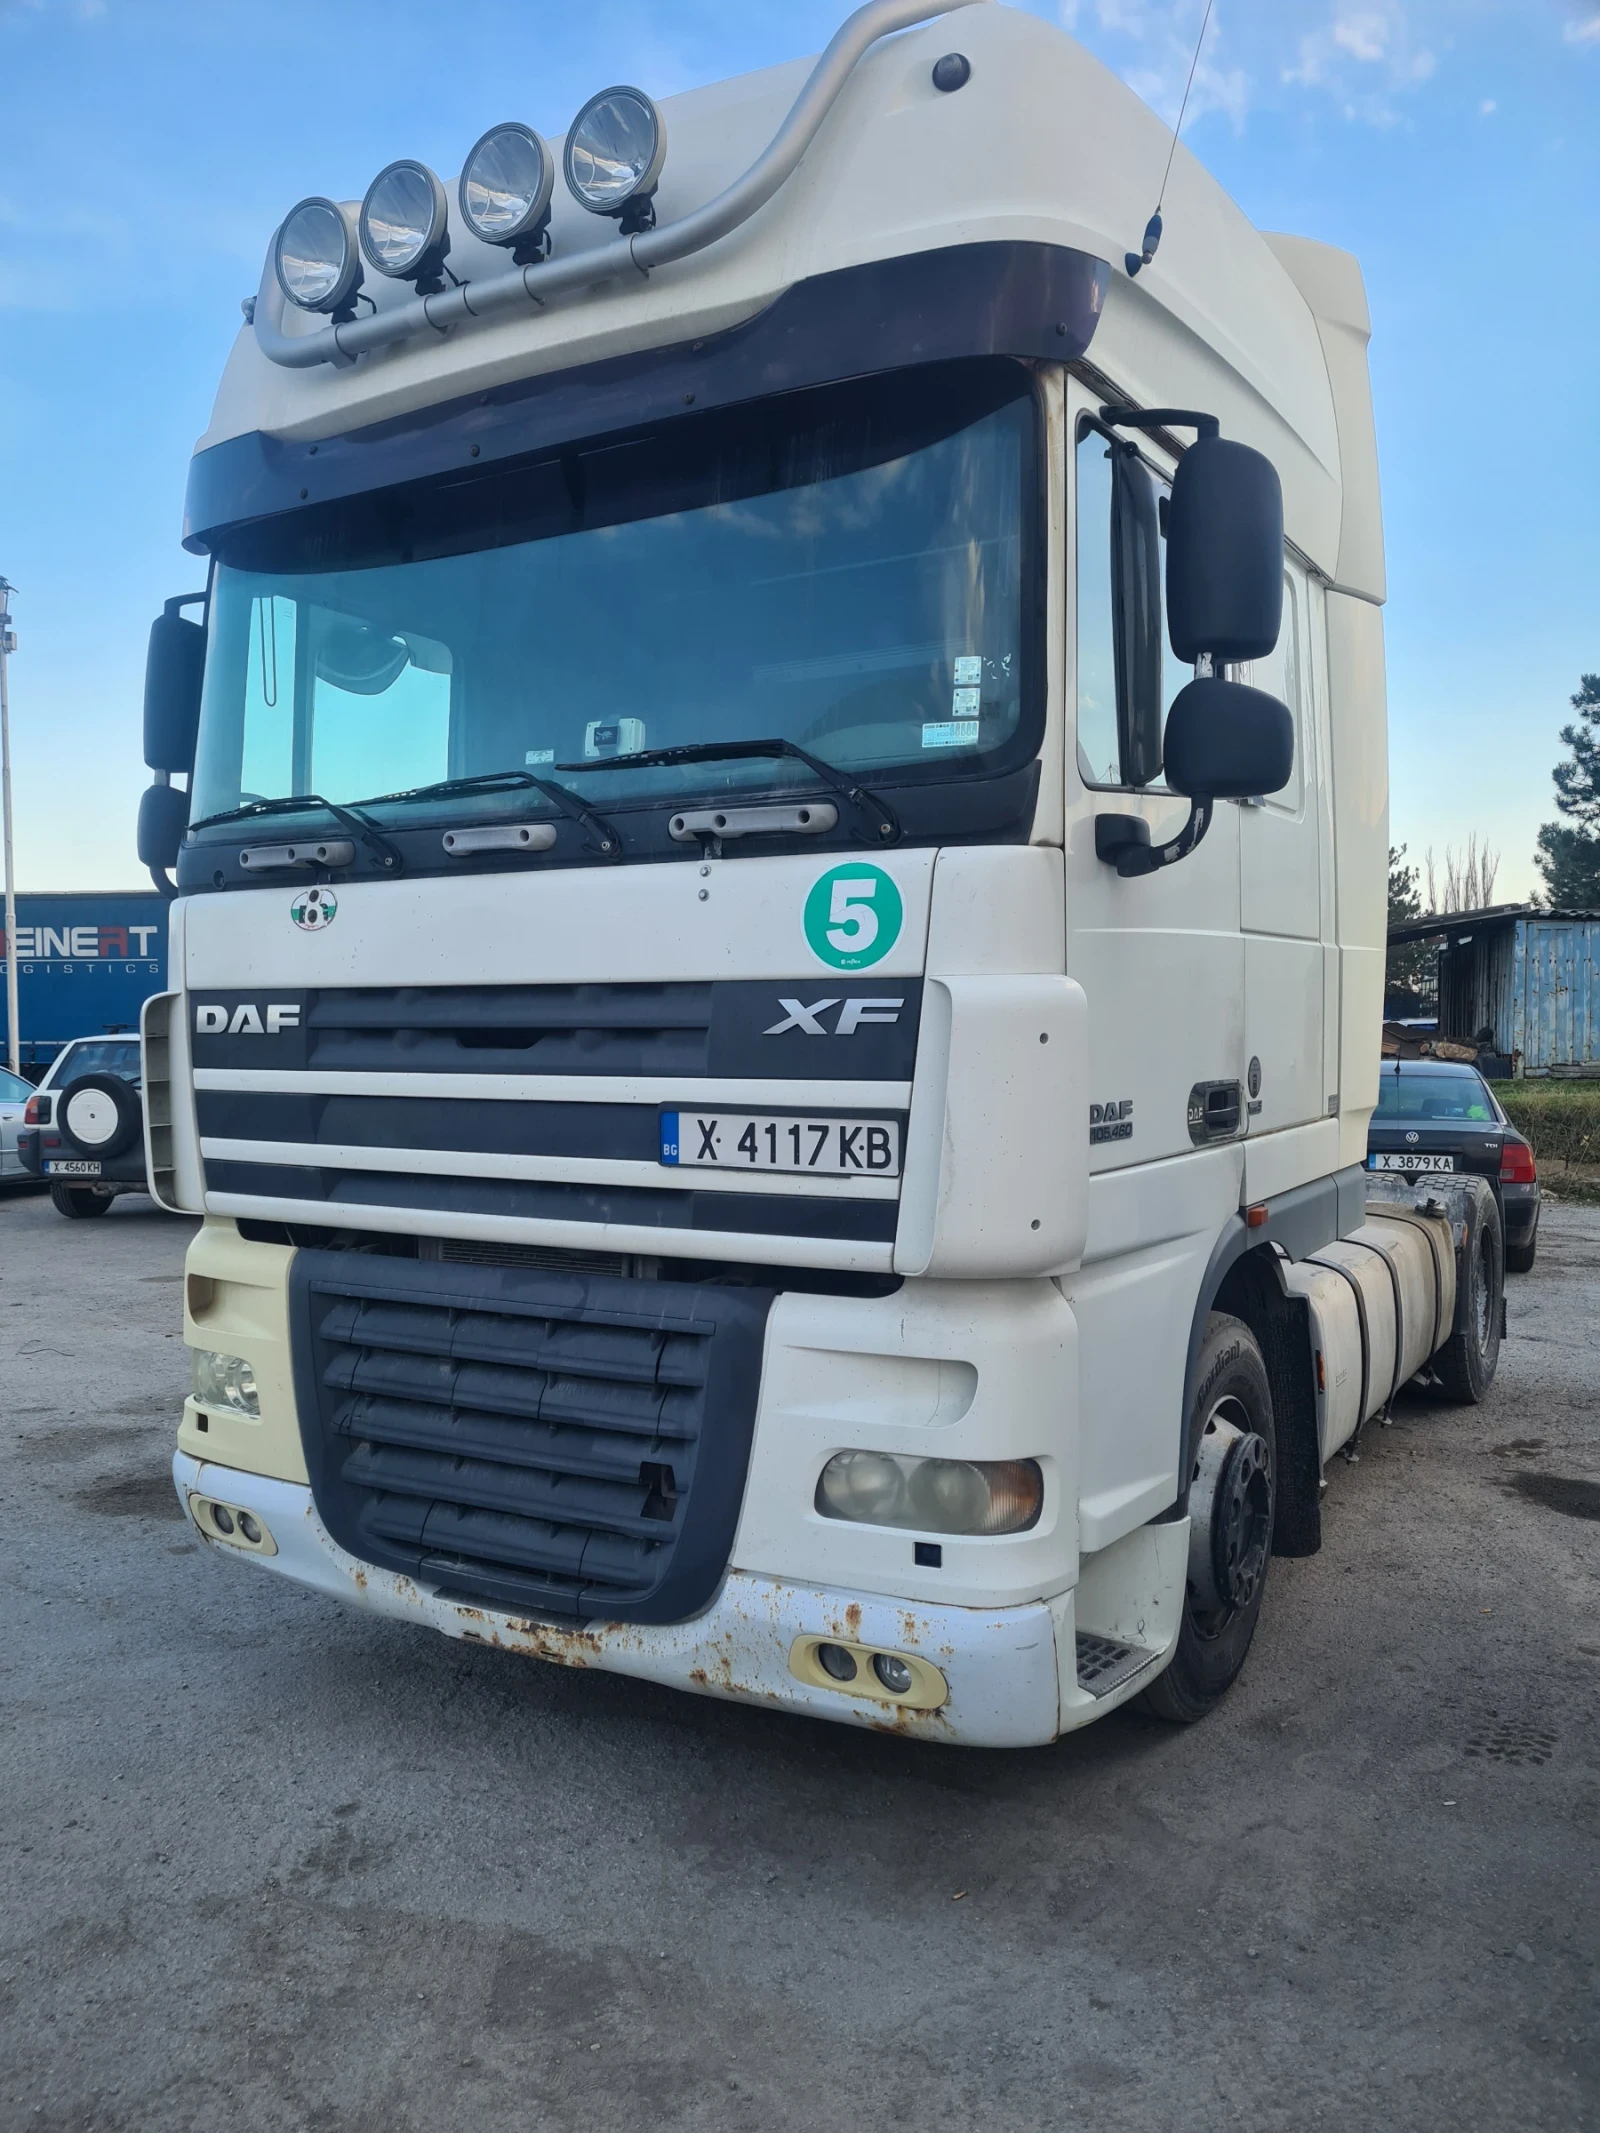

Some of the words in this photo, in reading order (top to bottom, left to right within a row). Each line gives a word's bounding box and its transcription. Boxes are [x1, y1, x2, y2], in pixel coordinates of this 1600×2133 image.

[825, 878, 879, 953] 5
[0, 926, 158, 957] EINERT
[196, 1004, 301, 1034] DAF
[762, 998, 905, 1035] XF
[1090, 1100, 1133, 1125] DAF
[1188, 1107, 1203, 1120] DAF
[663, 1144, 677, 1155] BG
